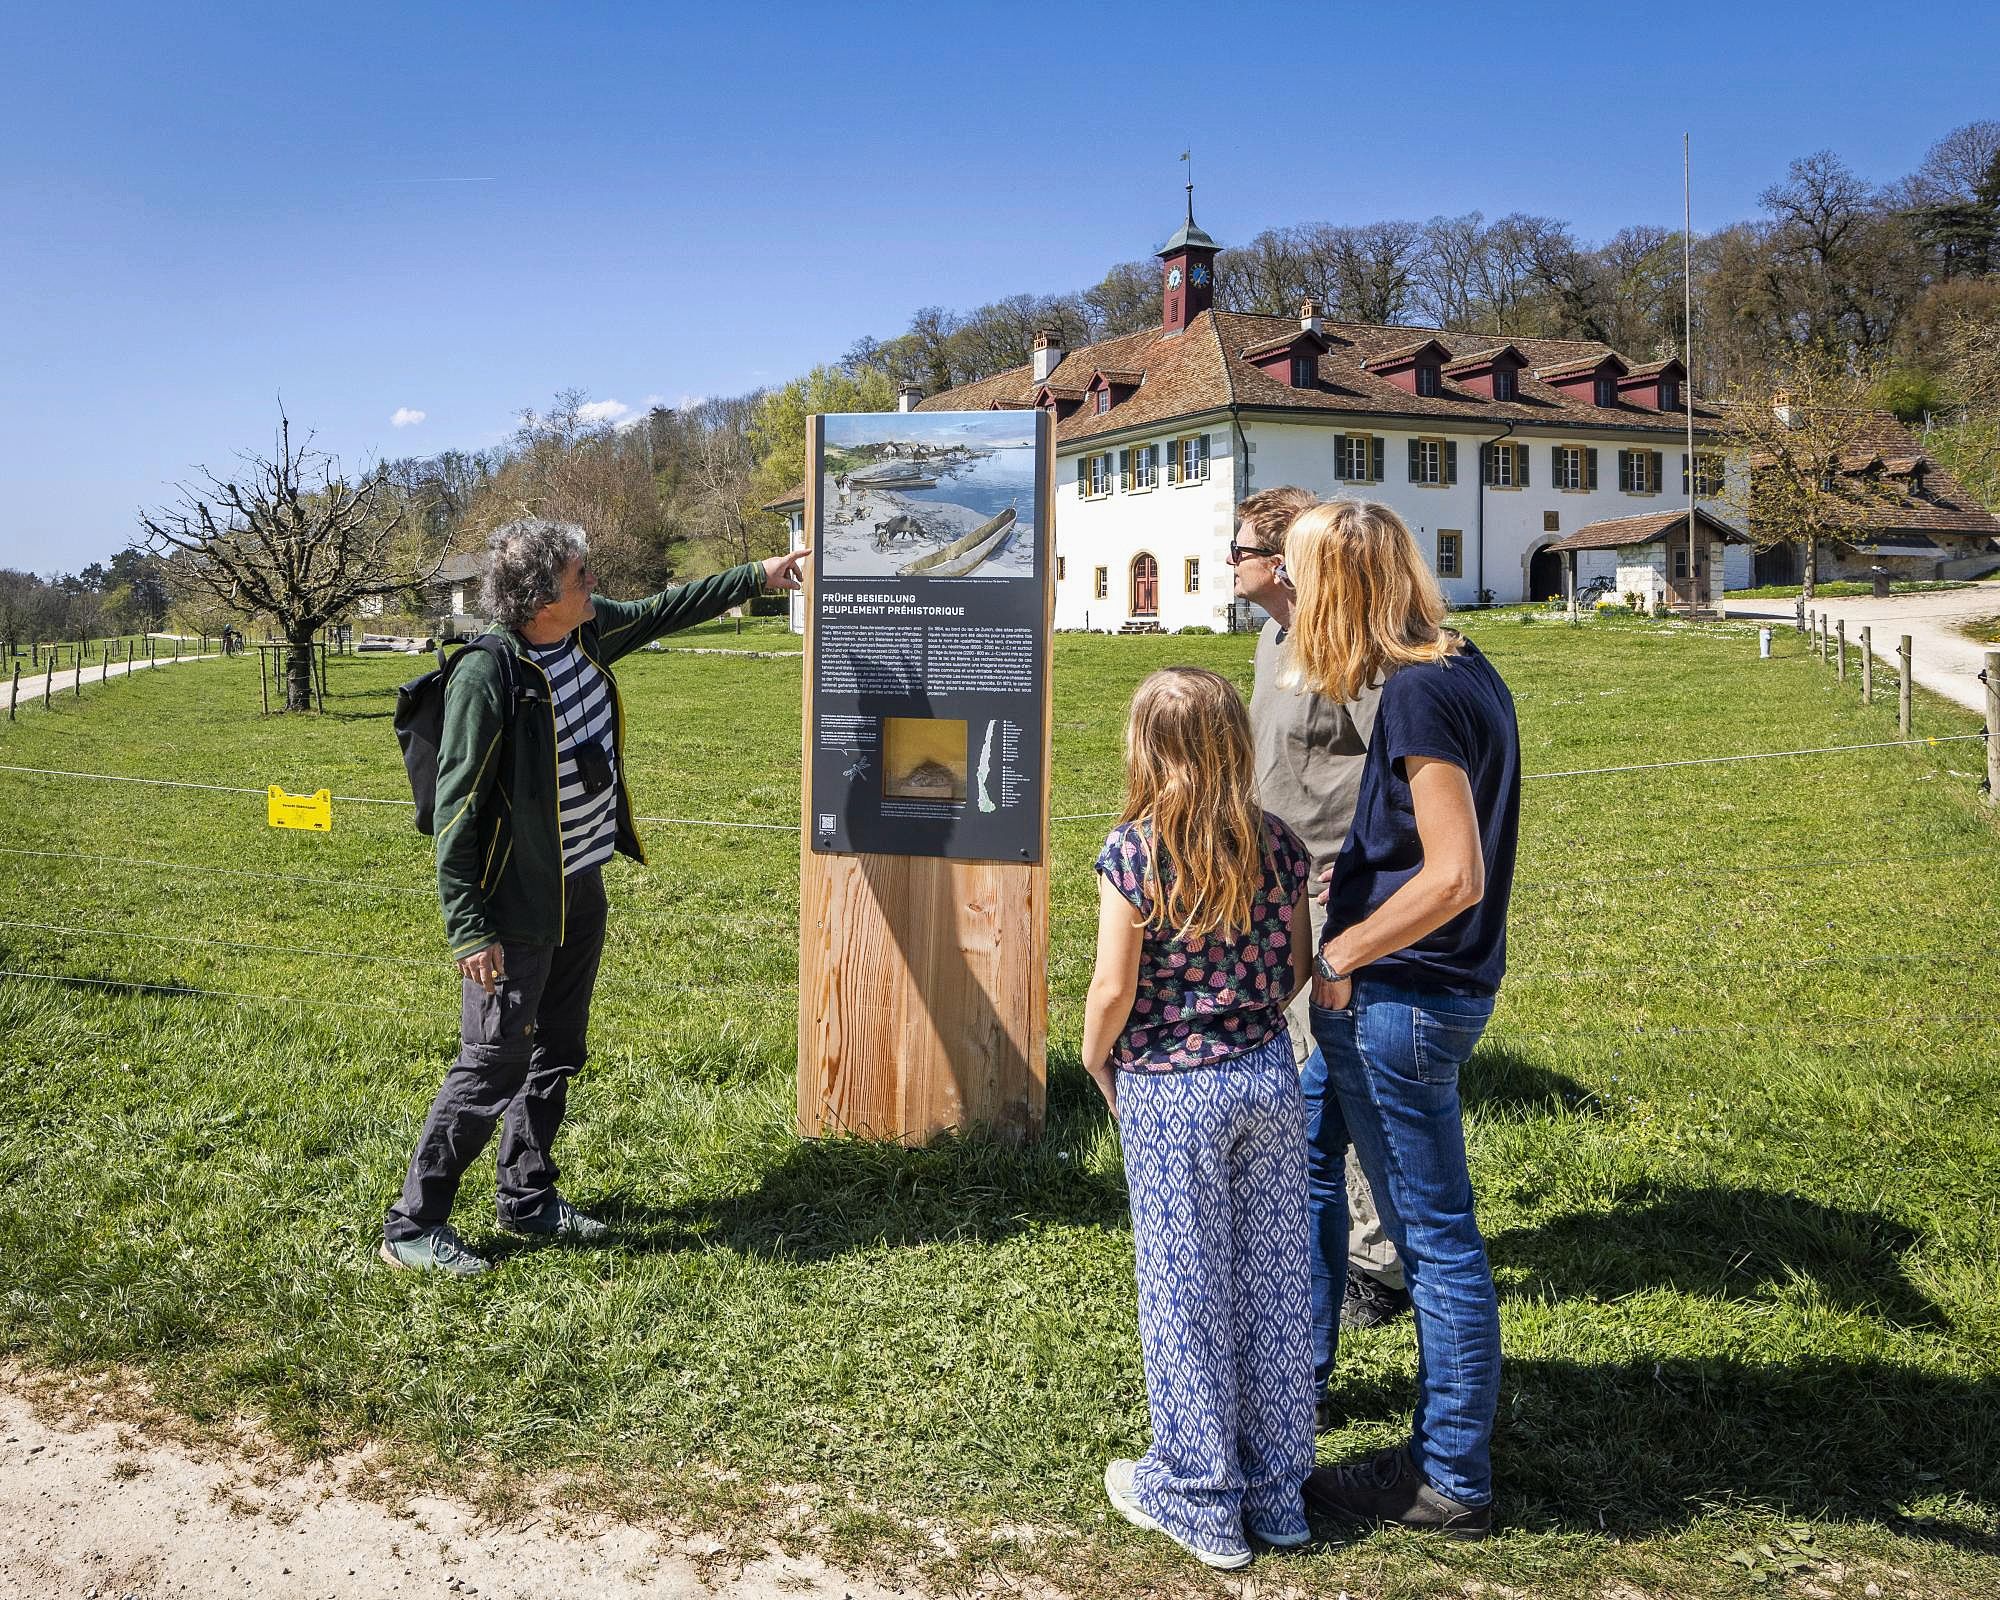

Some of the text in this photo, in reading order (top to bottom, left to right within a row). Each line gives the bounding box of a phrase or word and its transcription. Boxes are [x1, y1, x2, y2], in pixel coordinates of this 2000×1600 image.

[822, 592, 916, 603] FRÜHE BESIEDLUNG
[822, 606, 964, 616] PEUPLEMENT PRÉHISTORIQUE
